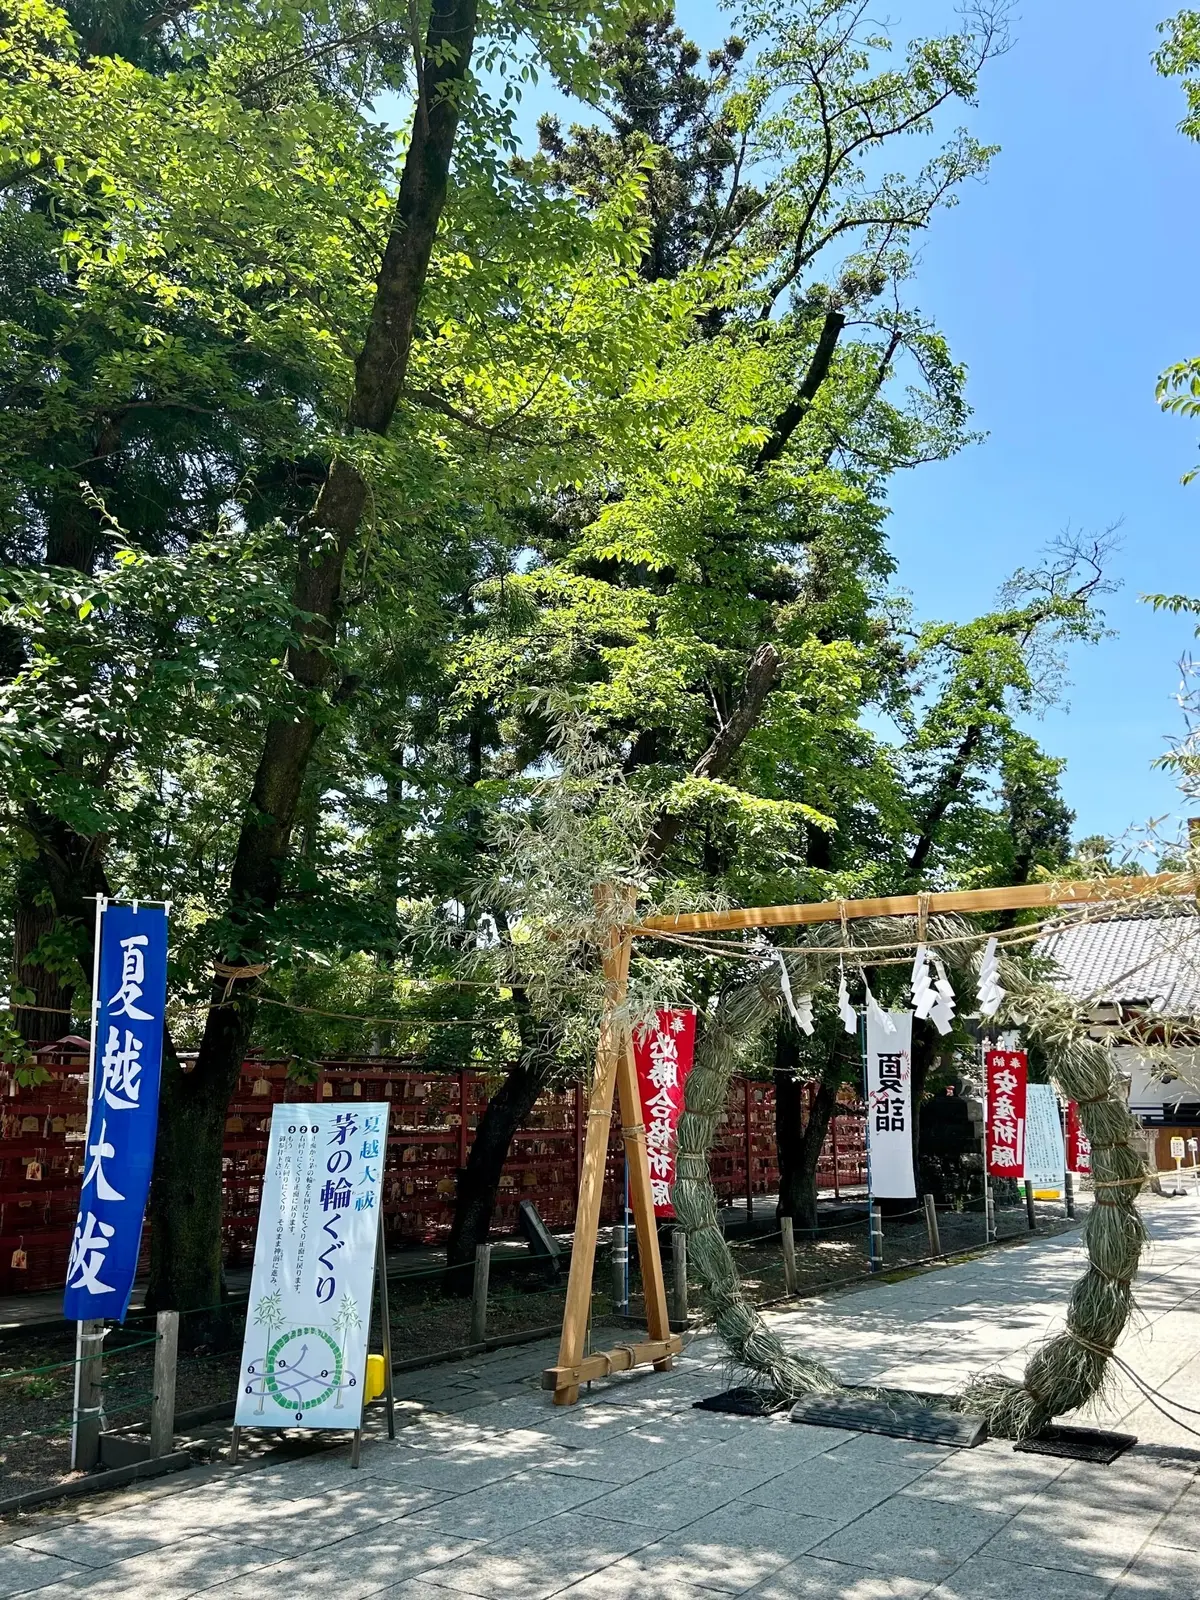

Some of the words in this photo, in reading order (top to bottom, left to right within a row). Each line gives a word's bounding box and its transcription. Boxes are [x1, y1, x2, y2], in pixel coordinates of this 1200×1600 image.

[66, 935, 155, 1293] 夏越大祓
[316, 1113, 358, 1304] 茅の輪くぐり
[354, 1114, 381, 1211] 夏越大祓
